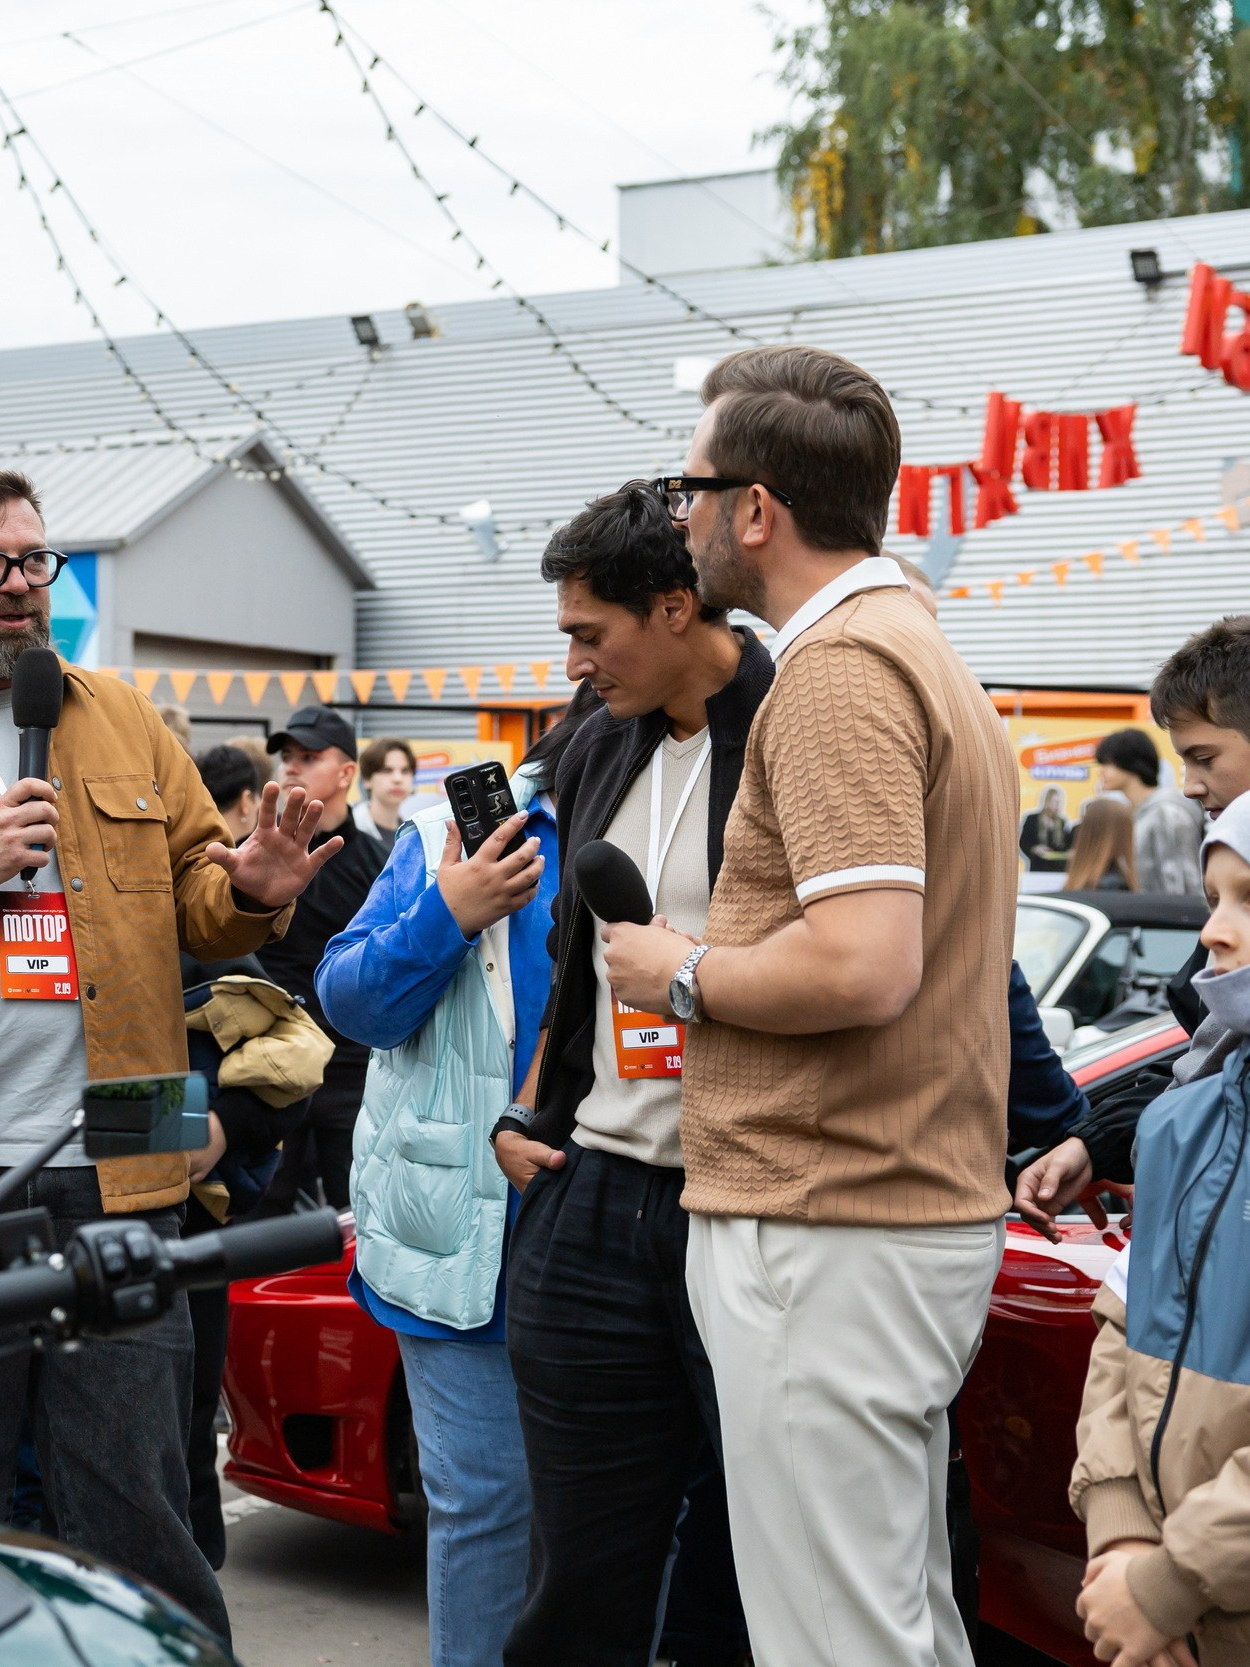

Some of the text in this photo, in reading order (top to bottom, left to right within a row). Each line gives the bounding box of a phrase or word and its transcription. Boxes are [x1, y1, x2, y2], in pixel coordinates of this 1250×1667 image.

[3, 914, 67, 942] МОТОР
[27, 959, 49, 970] VIP
[54, 982, 71, 994] 12.09
[639, 1031, 659, 1043] VIP
[665, 1055, 682, 1069] 12.09
